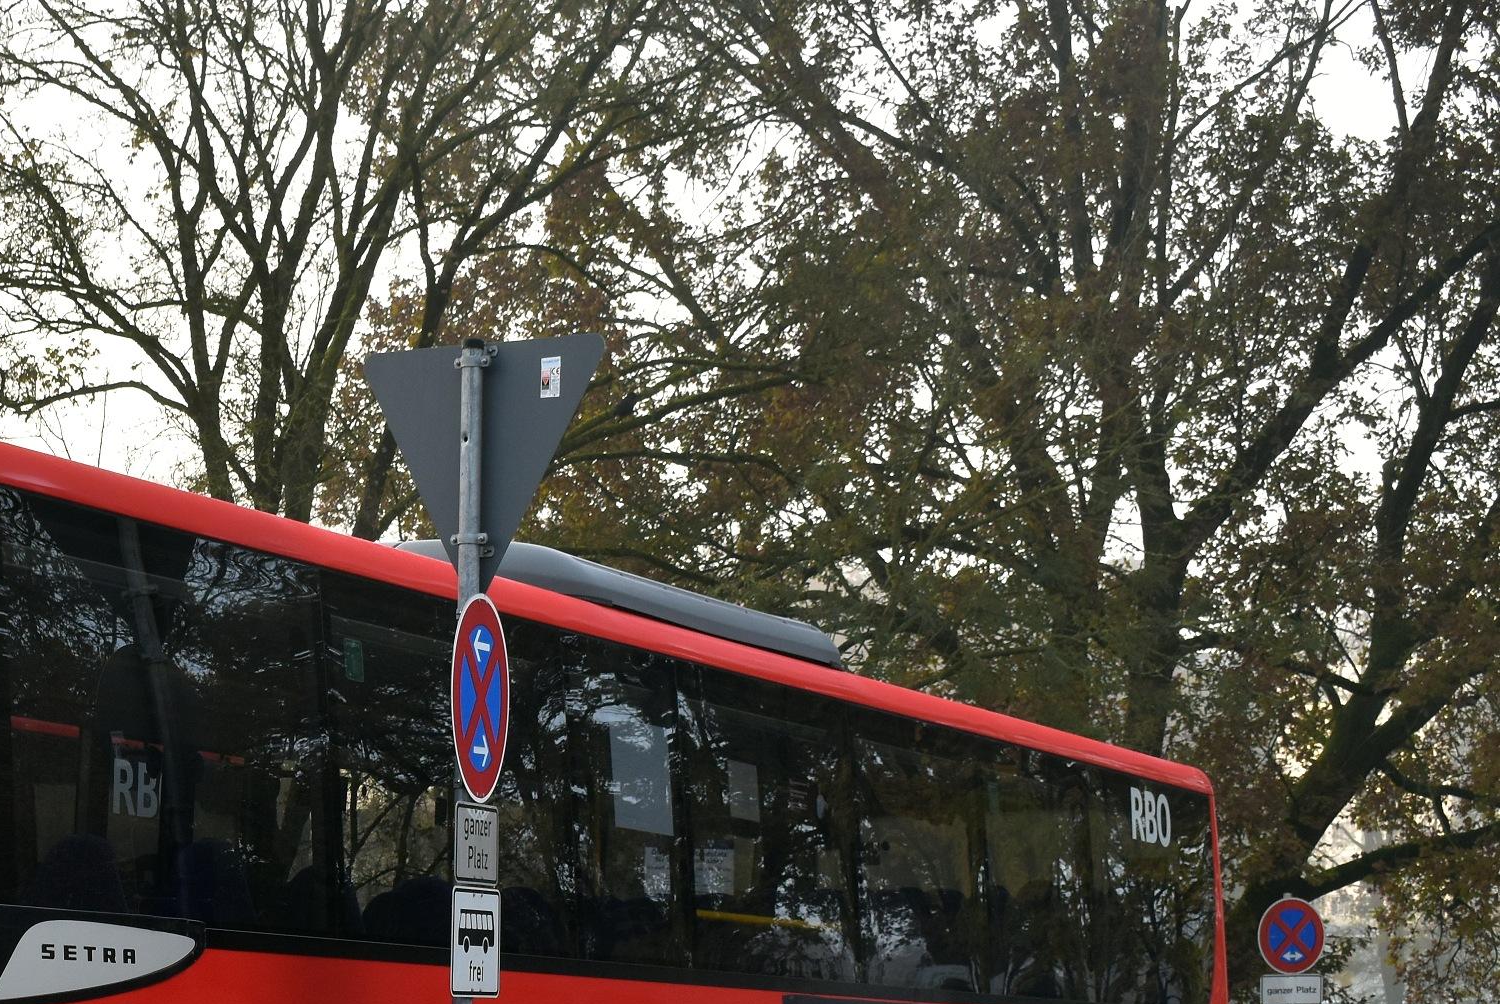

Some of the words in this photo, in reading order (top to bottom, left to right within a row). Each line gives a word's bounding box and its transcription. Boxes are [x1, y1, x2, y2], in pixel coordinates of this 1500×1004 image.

[112, 758, 162, 817] RB
[464, 816, 492, 841] ganzer
[1130, 786, 1171, 847] RBO
[467, 846, 488, 870] Platz
[41, 943, 136, 964] SETRA
[469, 961, 484, 982] frei
[1267, 988, 1293, 996] ganzer
[1296, 986, 1316, 994] Platz
